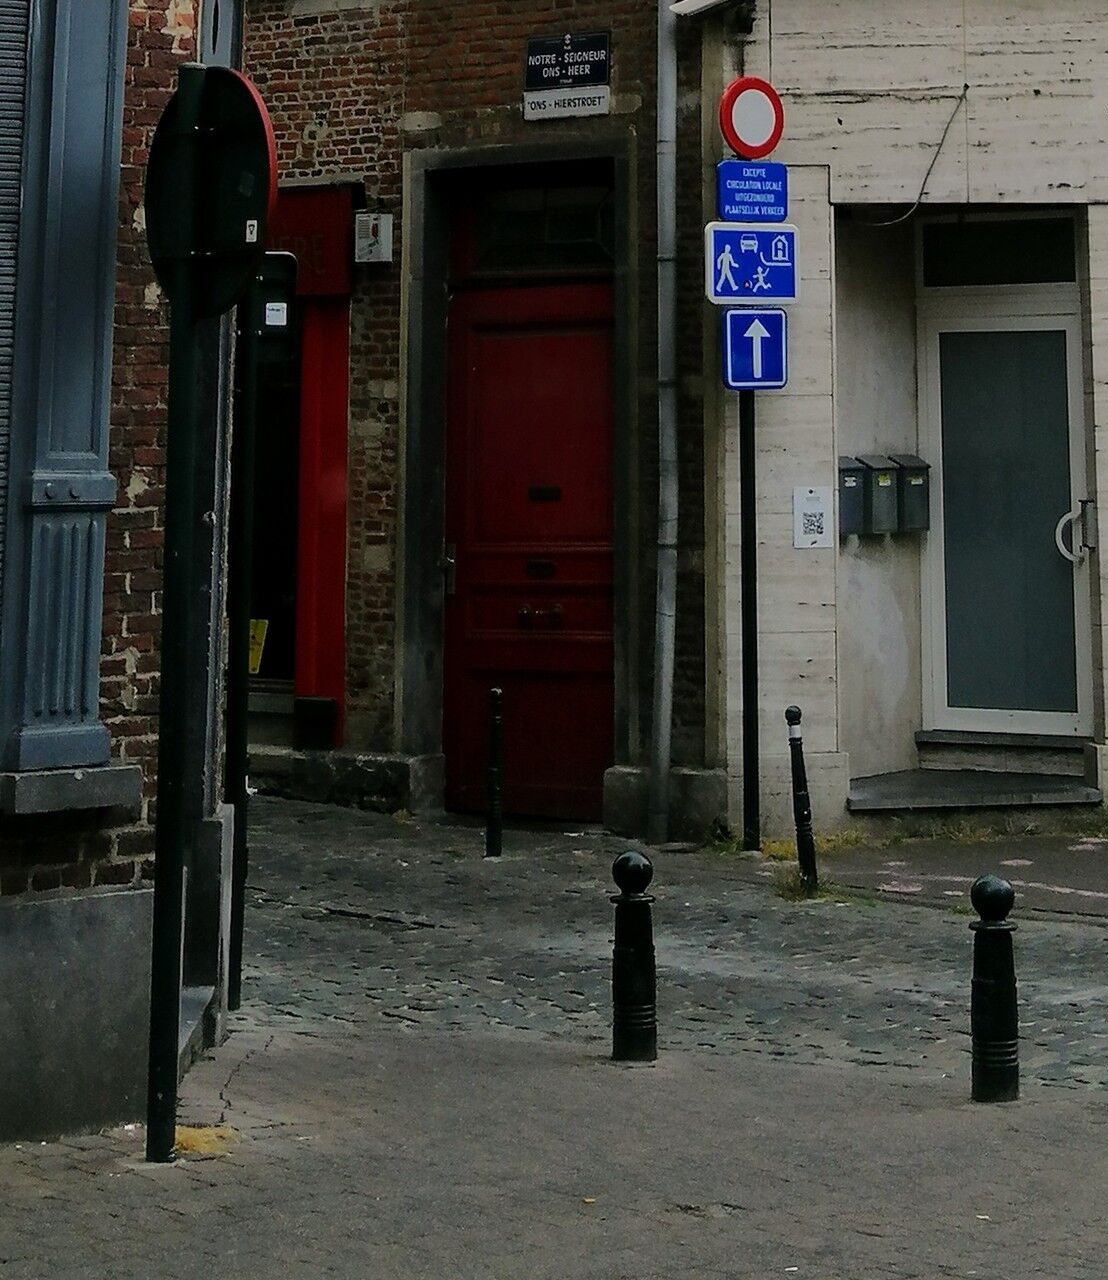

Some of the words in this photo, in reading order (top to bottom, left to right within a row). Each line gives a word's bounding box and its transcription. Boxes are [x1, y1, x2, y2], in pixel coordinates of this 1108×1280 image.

[528, 54, 556, 66] NOTRE
[564, 50, 606, 63] SEIGNEUR
[542, 66, 560, 78] ONS
[568, 64, 591, 76] HEER
